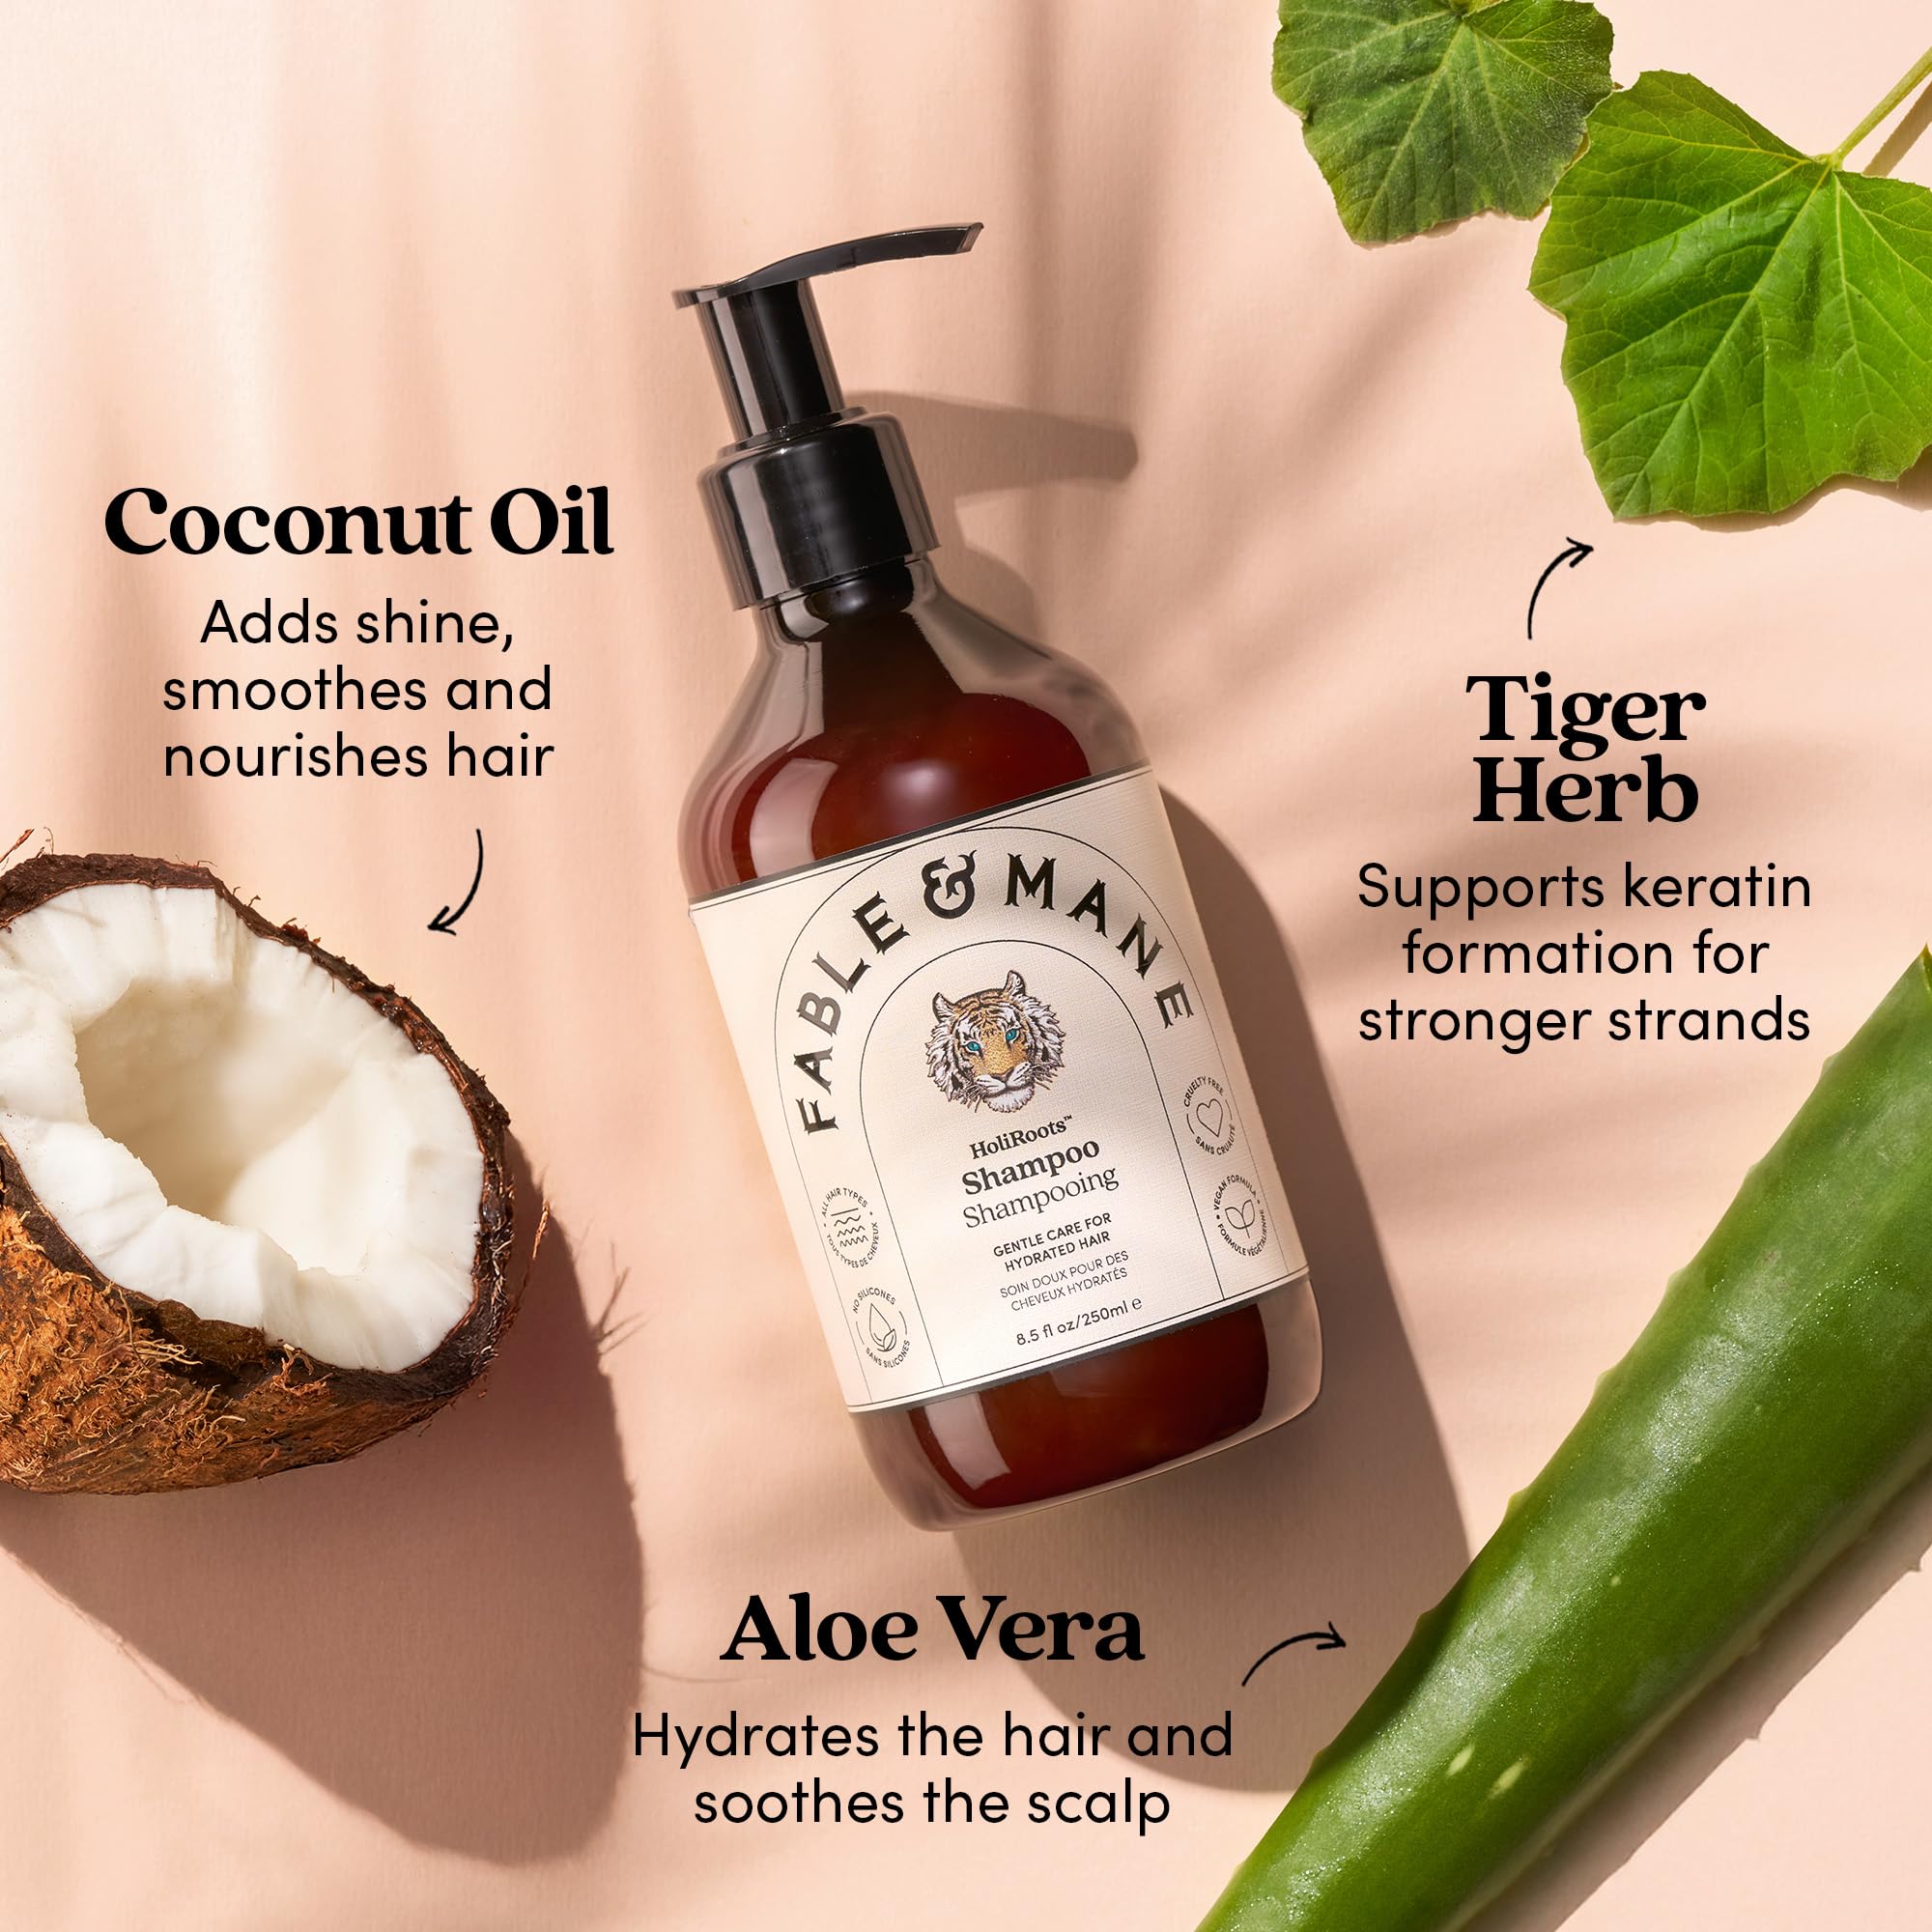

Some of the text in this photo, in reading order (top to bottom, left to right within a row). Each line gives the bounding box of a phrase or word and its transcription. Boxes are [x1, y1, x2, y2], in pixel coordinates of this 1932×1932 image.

[793, 849, 1194, 1136] FABLE & MANE
[1183, 1075, 1224, 1107] CRUELTY FREE
[1195, 1136, 1215, 1155] SANS
[961, 1140, 1100, 1196] Shampoo
[825, 1187, 842, 1203] HAIR
[842, 1187, 868, 1208] TYPES
[963, 1167, 1120, 1229] Shampooing
[1213, 1179, 1228, 1210] VEGAN
[827, 1222, 880, 1268] TOUS TYPES DE CHEVEUX
[993, 1212, 1112, 1257] GENTLE CARE FOR
[1005, 1231, 1111, 1272] HYDRATED HAIR
[1217, 1223, 1246, 1257] FORMULE
[1000, 1250, 1129, 1298] SOIN DOUX POUR DES
[1010, 1266, 1128, 1312] CHEVEUX HYDRATÉS
[853, 1287, 896, 1314] NO SILICONES
[1016, 1328, 1039, 1346] 8.5
[1041, 1322, 1054, 1339] fl
[1057, 1299, 1128, 1334] oz/250ml
[866, 1340, 911, 1368] SANS SILICONES
